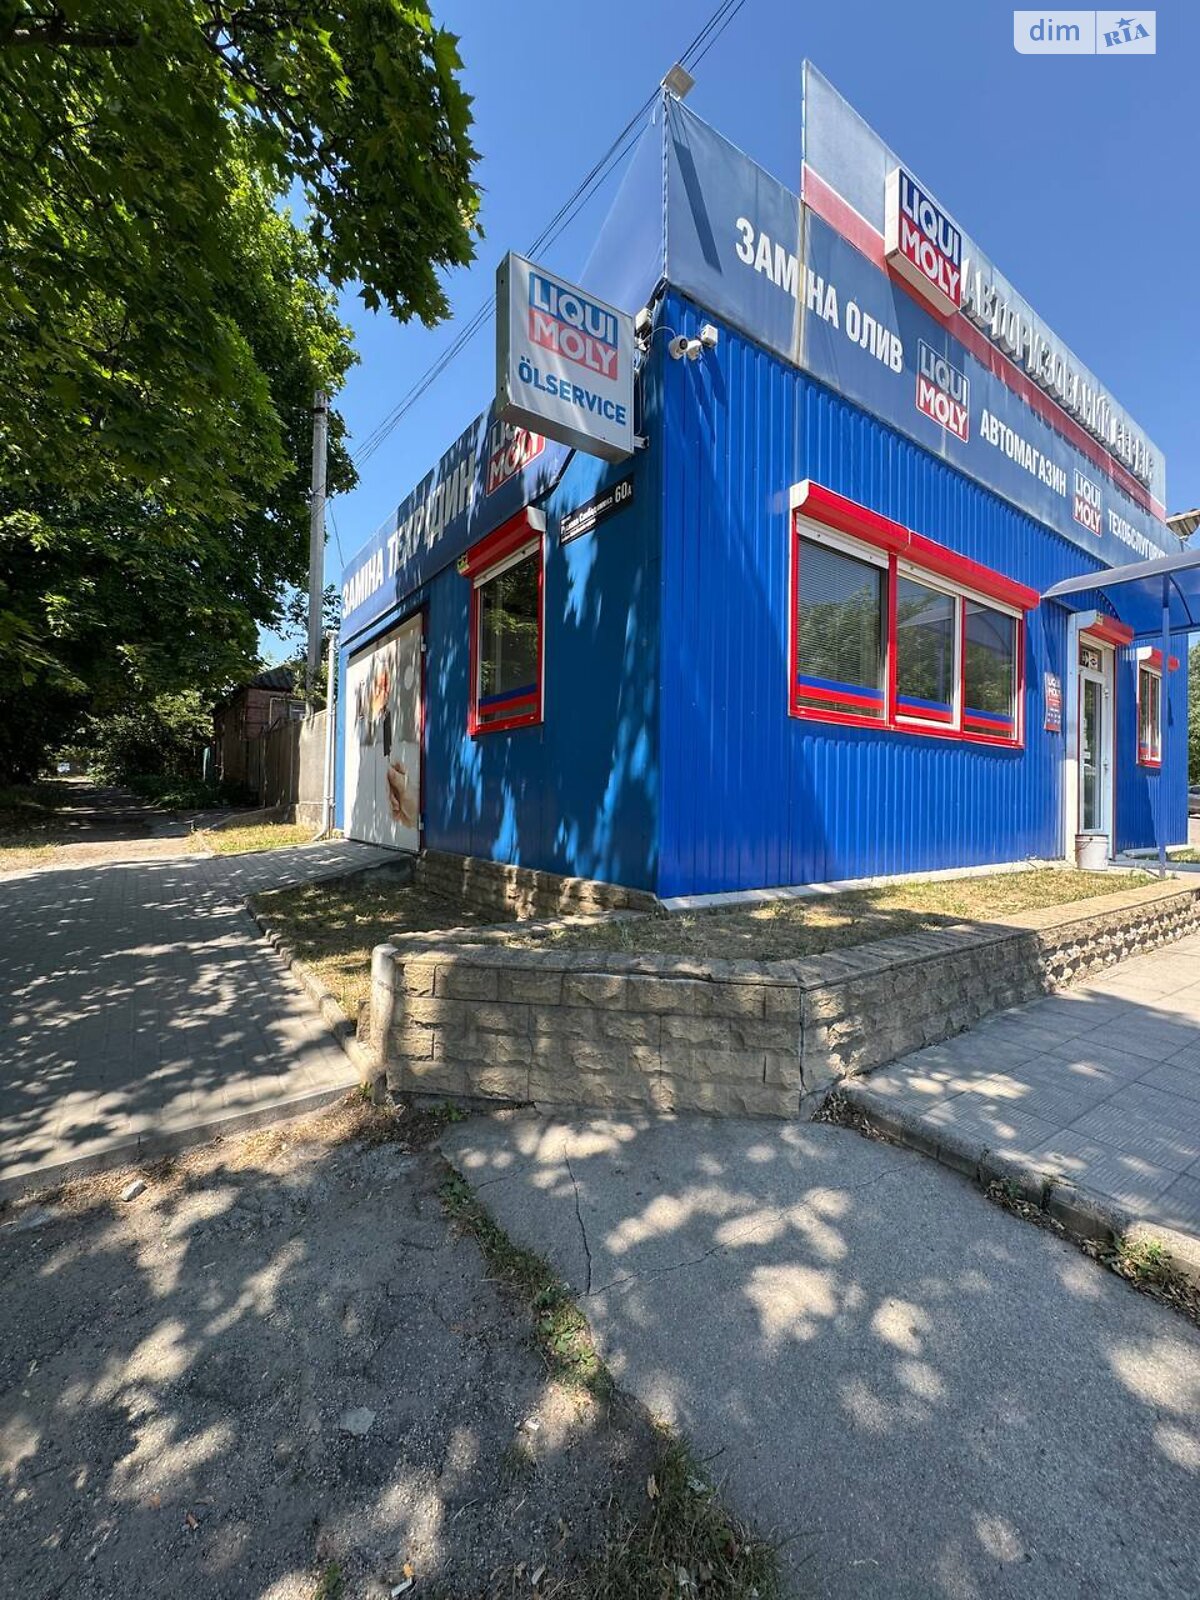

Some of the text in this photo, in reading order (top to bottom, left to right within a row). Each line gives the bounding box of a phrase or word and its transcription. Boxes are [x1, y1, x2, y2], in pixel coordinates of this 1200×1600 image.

[901, 174, 961, 265] LIQUI
[735, 217, 904, 375] ЗАМІНА ОЛИВ
[901, 222, 961, 301] MOLY
[534, 277, 614, 345] LIQUI
[534, 313, 617, 375] MOLY
[518, 355, 627, 426] ÖLSERVICE
[918, 379, 968, 437] MOLY
[919, 345, 967, 407] LIQUI
[979, 409, 1067, 498] АВТОМАГАЗИН
[1074, 495, 1101, 534] MOLY
[1075, 471, 1101, 511] LIQUI
[342, 547, 385, 620] ЗАМІНА
